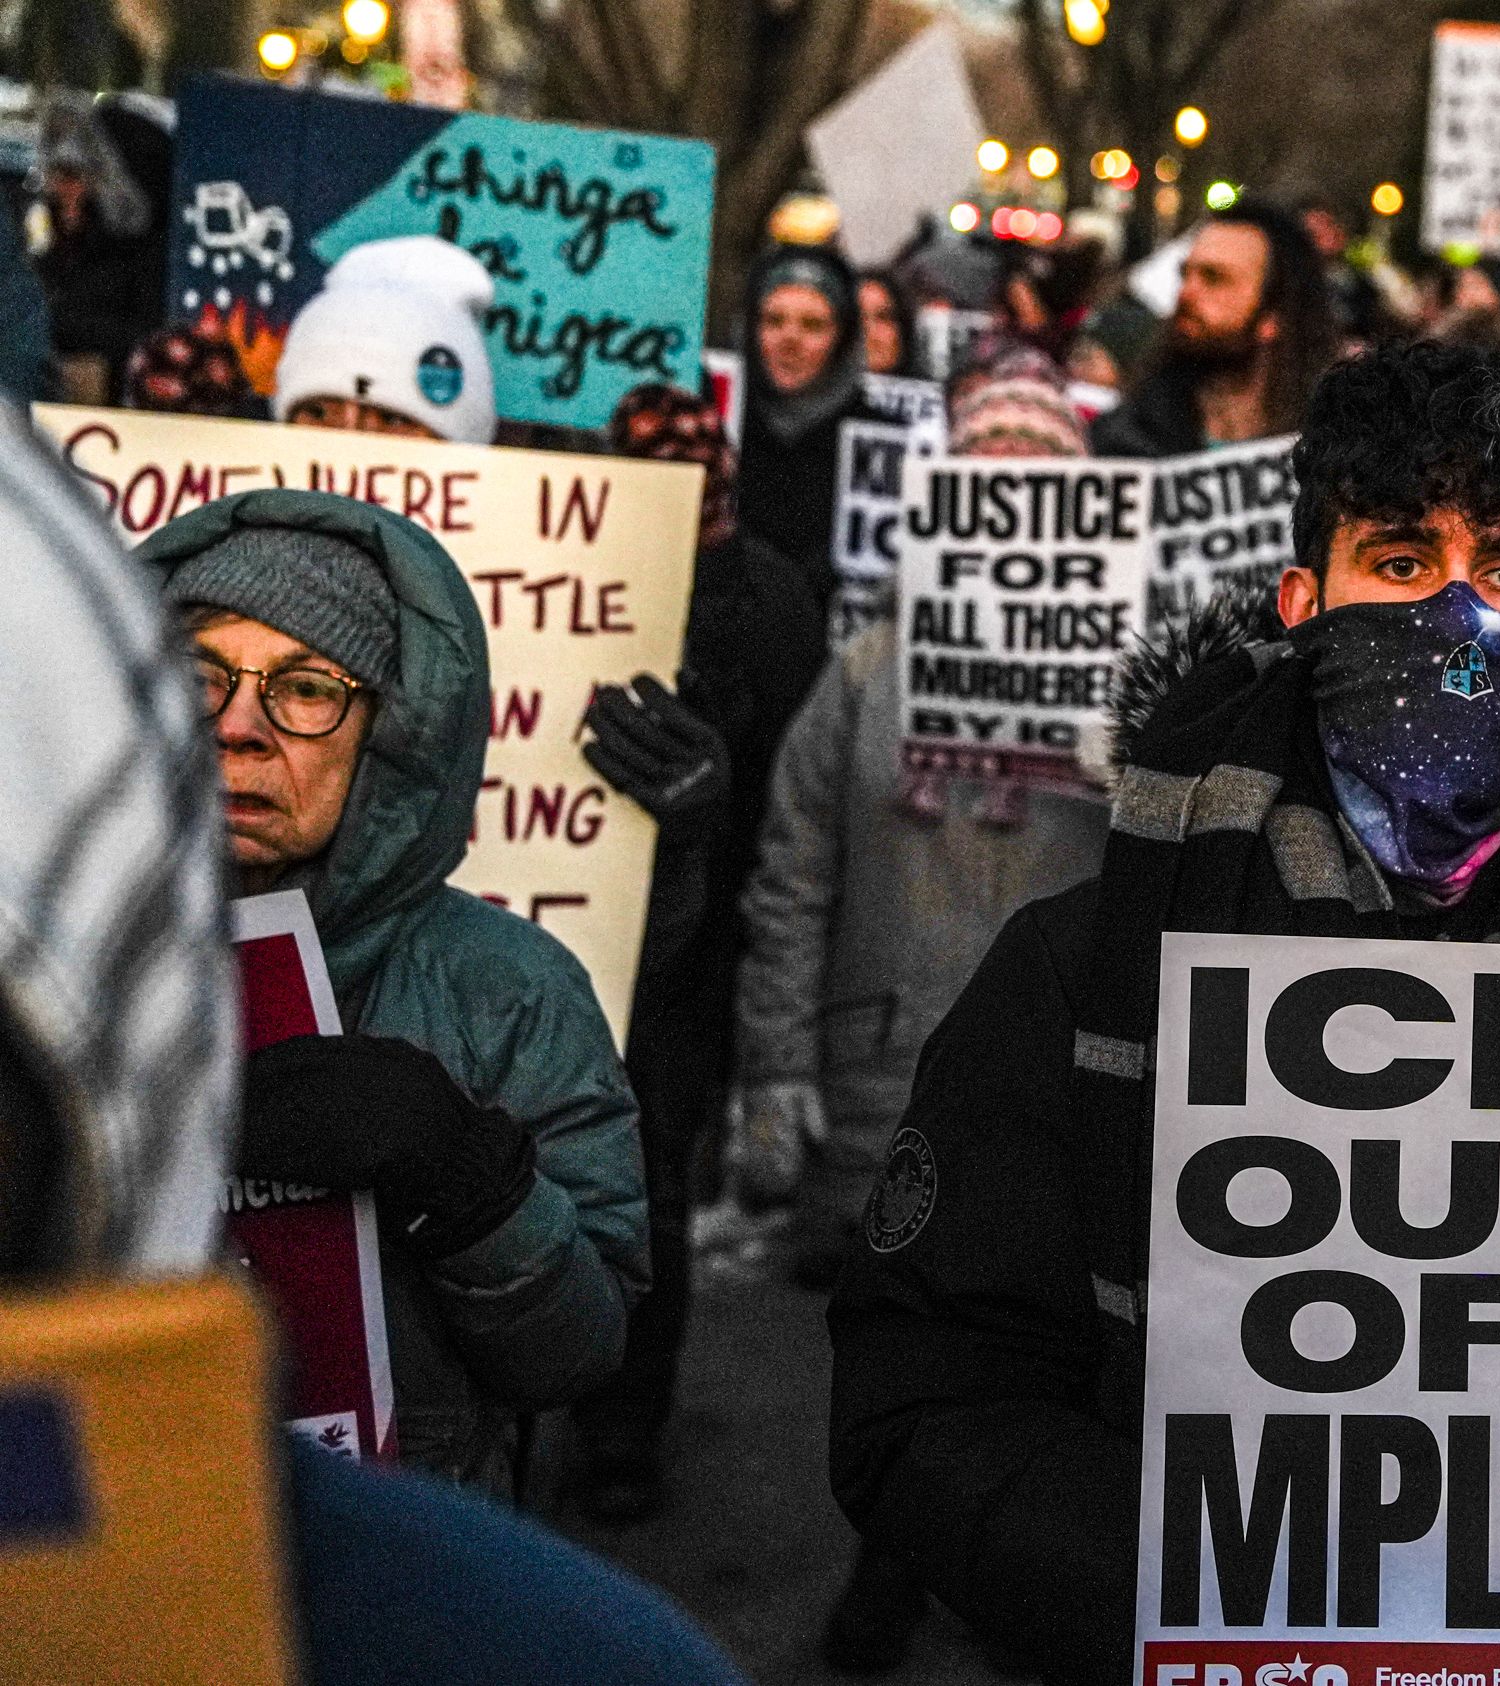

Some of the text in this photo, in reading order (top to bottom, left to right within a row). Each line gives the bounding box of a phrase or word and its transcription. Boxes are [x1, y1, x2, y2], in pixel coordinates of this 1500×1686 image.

[538, 475, 611, 545] IN
[907, 471, 1141, 541] JUSTICE
[939, 551, 1107, 592] FOR
[1160, 521, 1281, 571] FOR
[910, 598, 985, 650] ALL
[1001, 601, 1131, 652] THOSE
[909, 653, 1113, 709] MURDERE
[911, 707, 1002, 741] BY
[1376, 1667, 1486, 1686] Freedom
